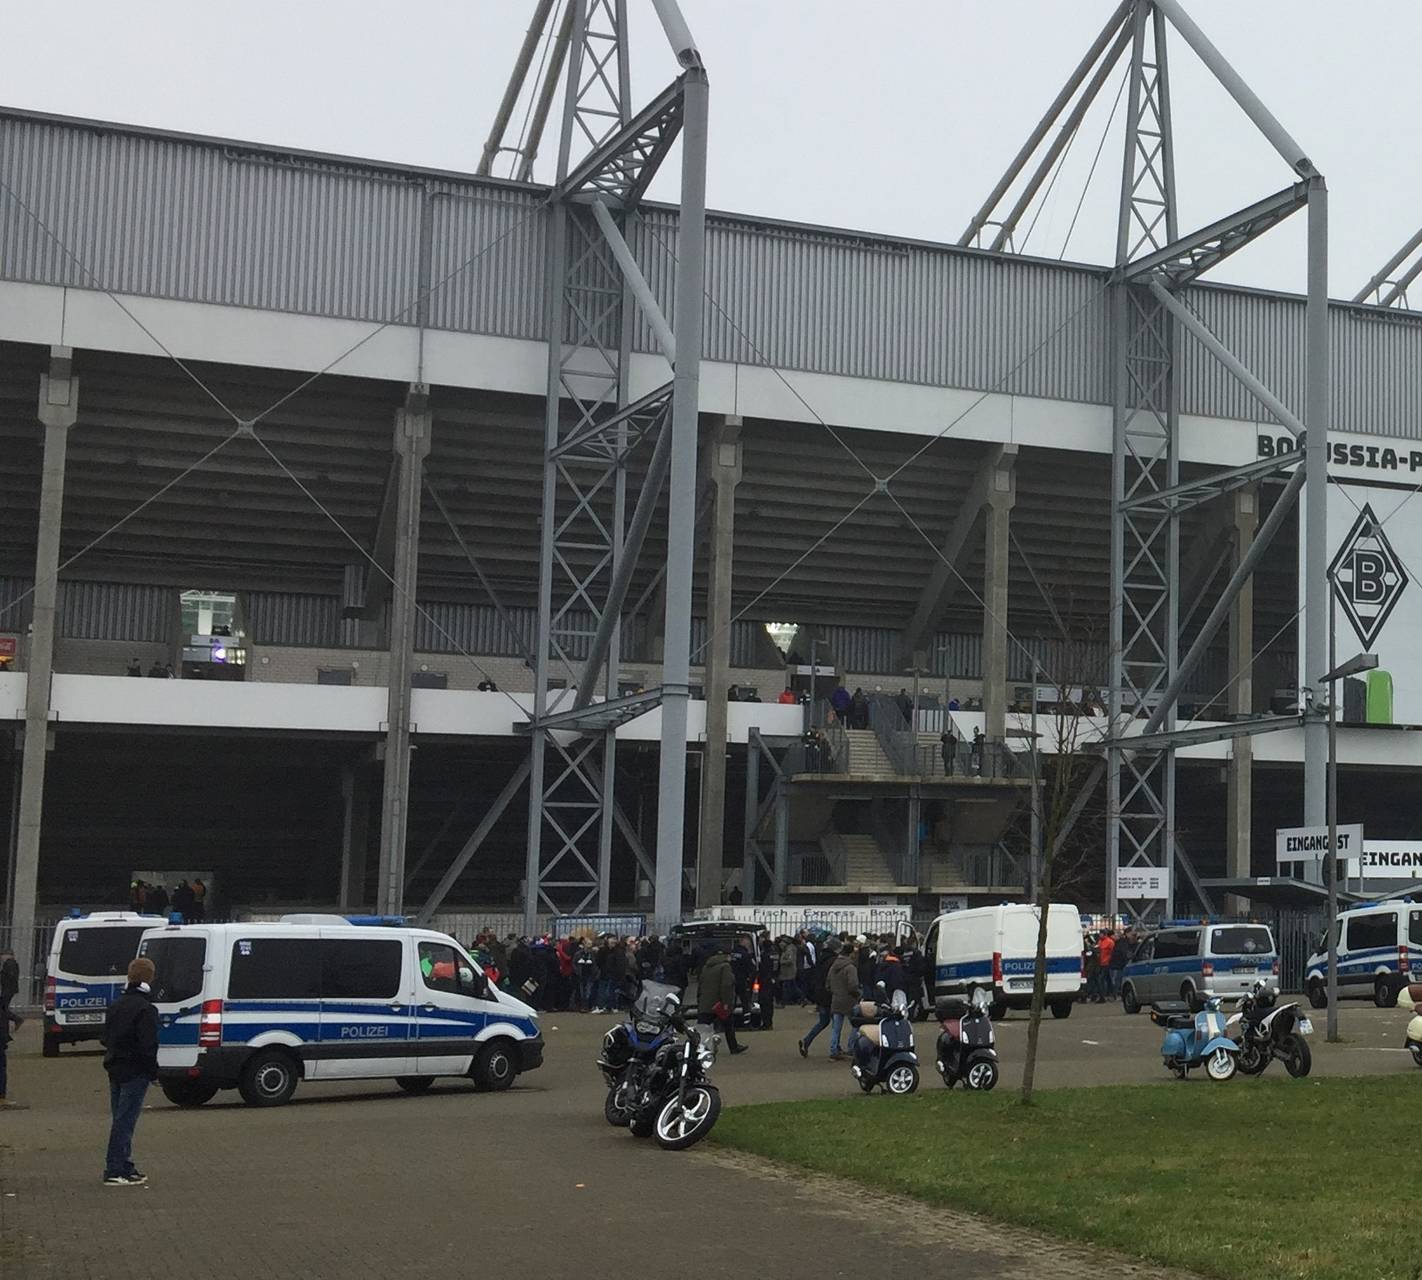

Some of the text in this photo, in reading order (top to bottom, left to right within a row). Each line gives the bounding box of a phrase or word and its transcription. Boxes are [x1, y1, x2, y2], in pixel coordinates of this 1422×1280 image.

[1353, 551, 1387, 604] B
[1286, 834, 1330, 852] EINGANG
[753, 909, 788, 917] Fisch
[803, 909, 855, 918] Express
[870, 908, 907, 917] Brake
[60, 997, 107, 1007] POLIZEI
[340, 1026, 389, 1038] POLIZEI
